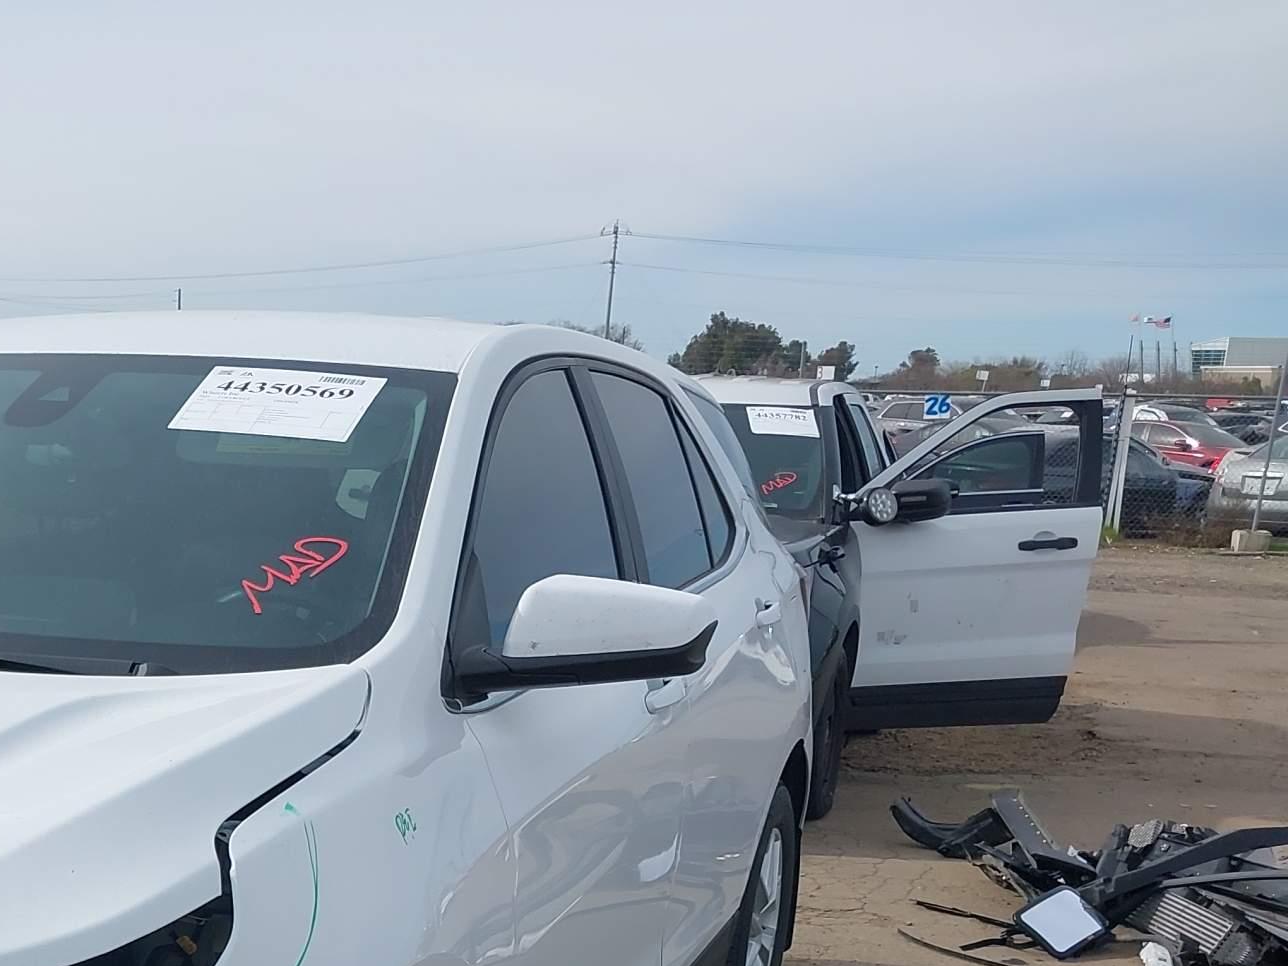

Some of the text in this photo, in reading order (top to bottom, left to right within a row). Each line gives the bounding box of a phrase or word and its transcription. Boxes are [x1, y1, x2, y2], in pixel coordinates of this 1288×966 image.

[216, 379, 355, 400] 44350569
[925, 395, 951, 416] 26
[760, 471, 798, 495] MAD
[241, 536, 349, 614] MAD
